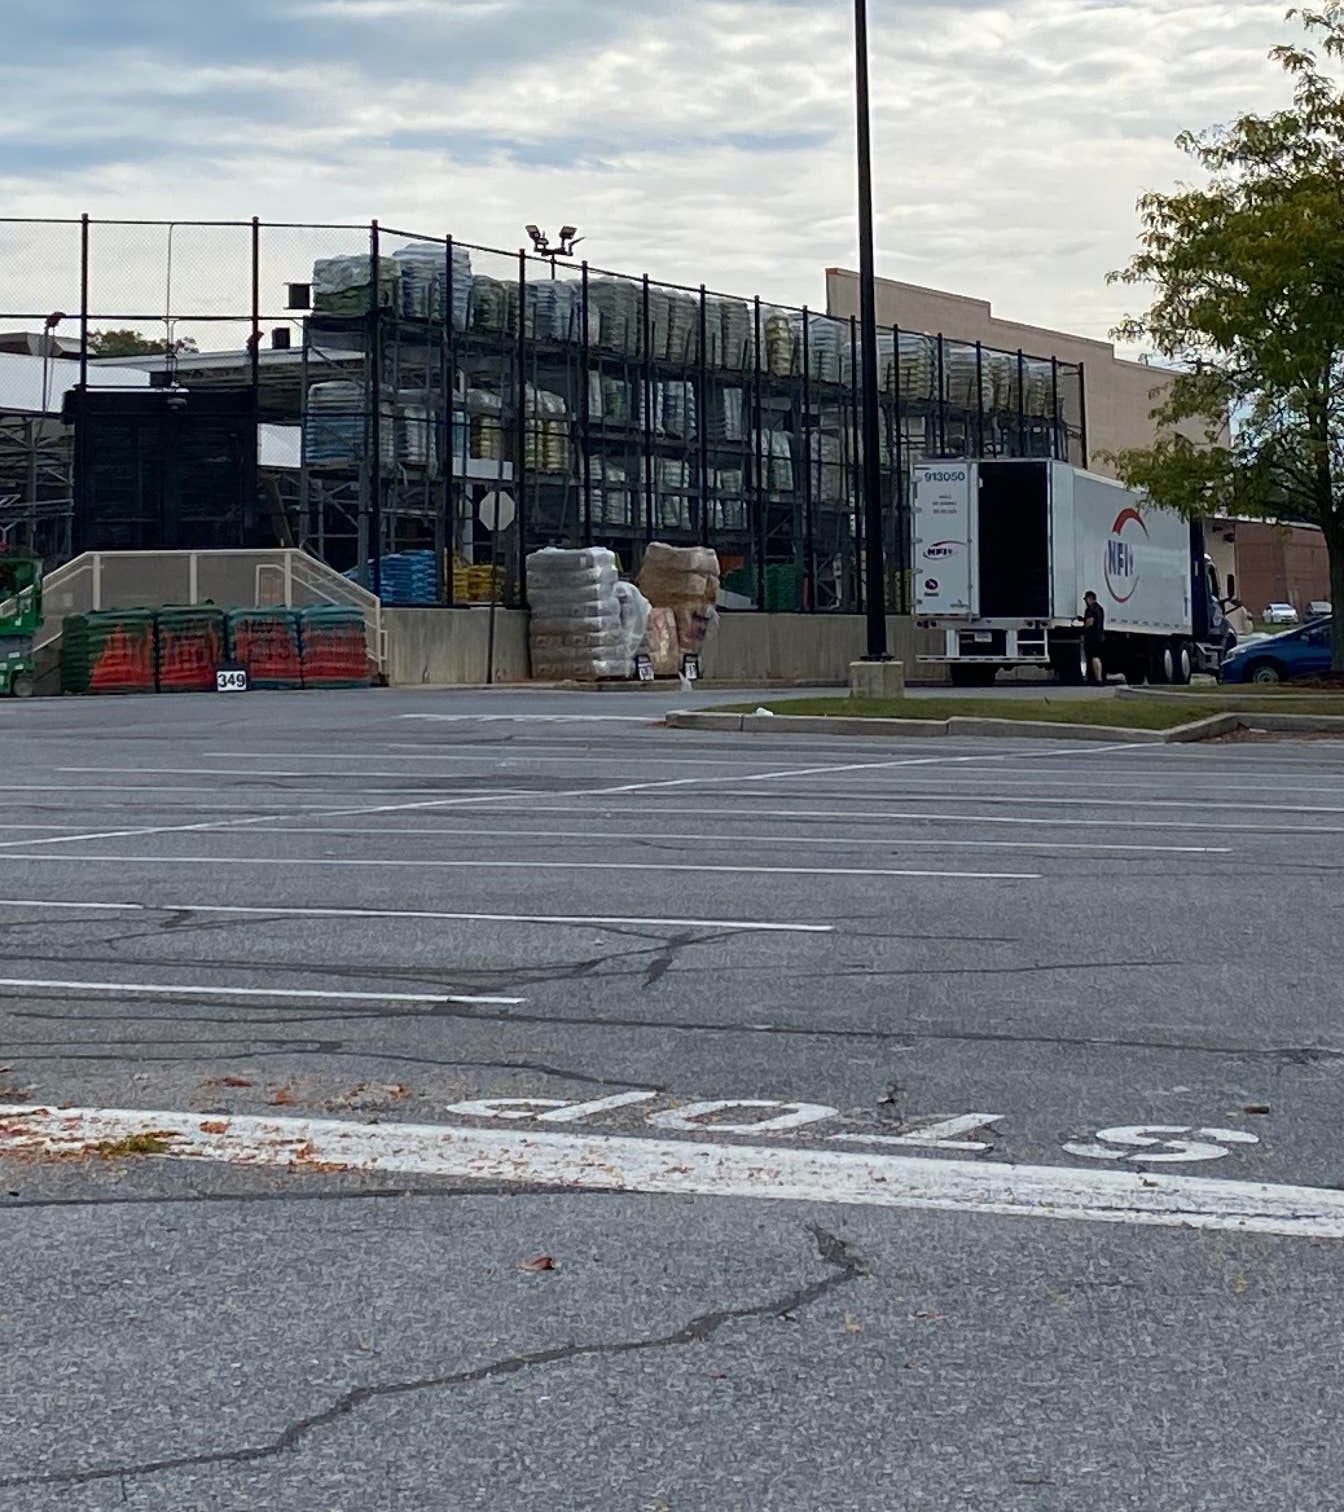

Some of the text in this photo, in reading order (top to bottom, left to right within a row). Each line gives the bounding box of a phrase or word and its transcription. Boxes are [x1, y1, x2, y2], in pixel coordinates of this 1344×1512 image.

[924, 471, 965, 482] 913050
[218, 673, 246, 688] 349
[446, 1090, 1260, 1163] STOP
